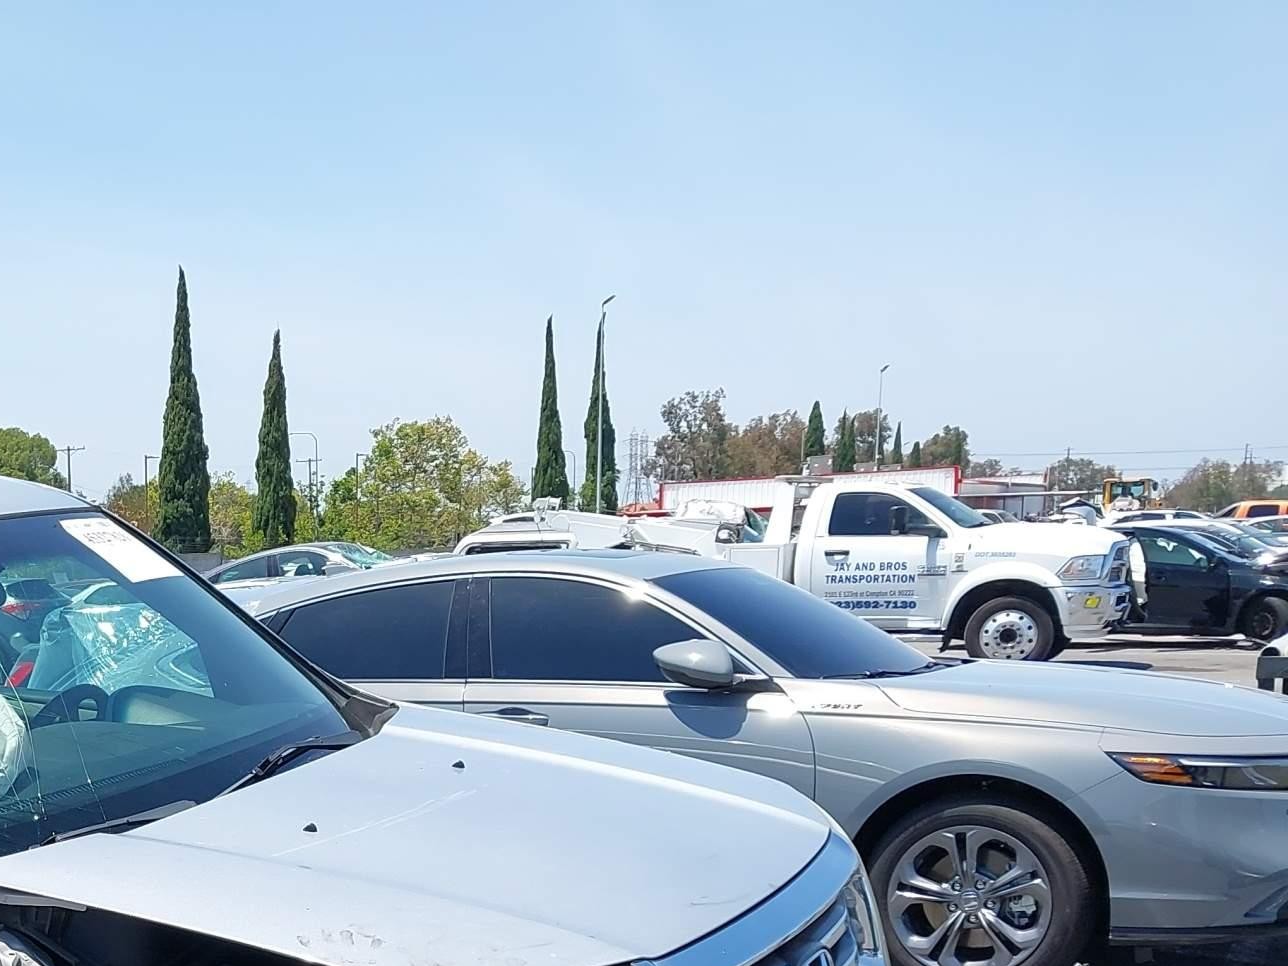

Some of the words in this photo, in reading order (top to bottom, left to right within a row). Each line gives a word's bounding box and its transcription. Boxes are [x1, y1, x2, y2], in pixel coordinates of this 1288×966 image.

[834, 562, 852, 572] JAY
[854, 562, 876, 572] AND
[879, 561, 908, 571] BROS
[824, 574, 916, 584] TRANSPORTATION
